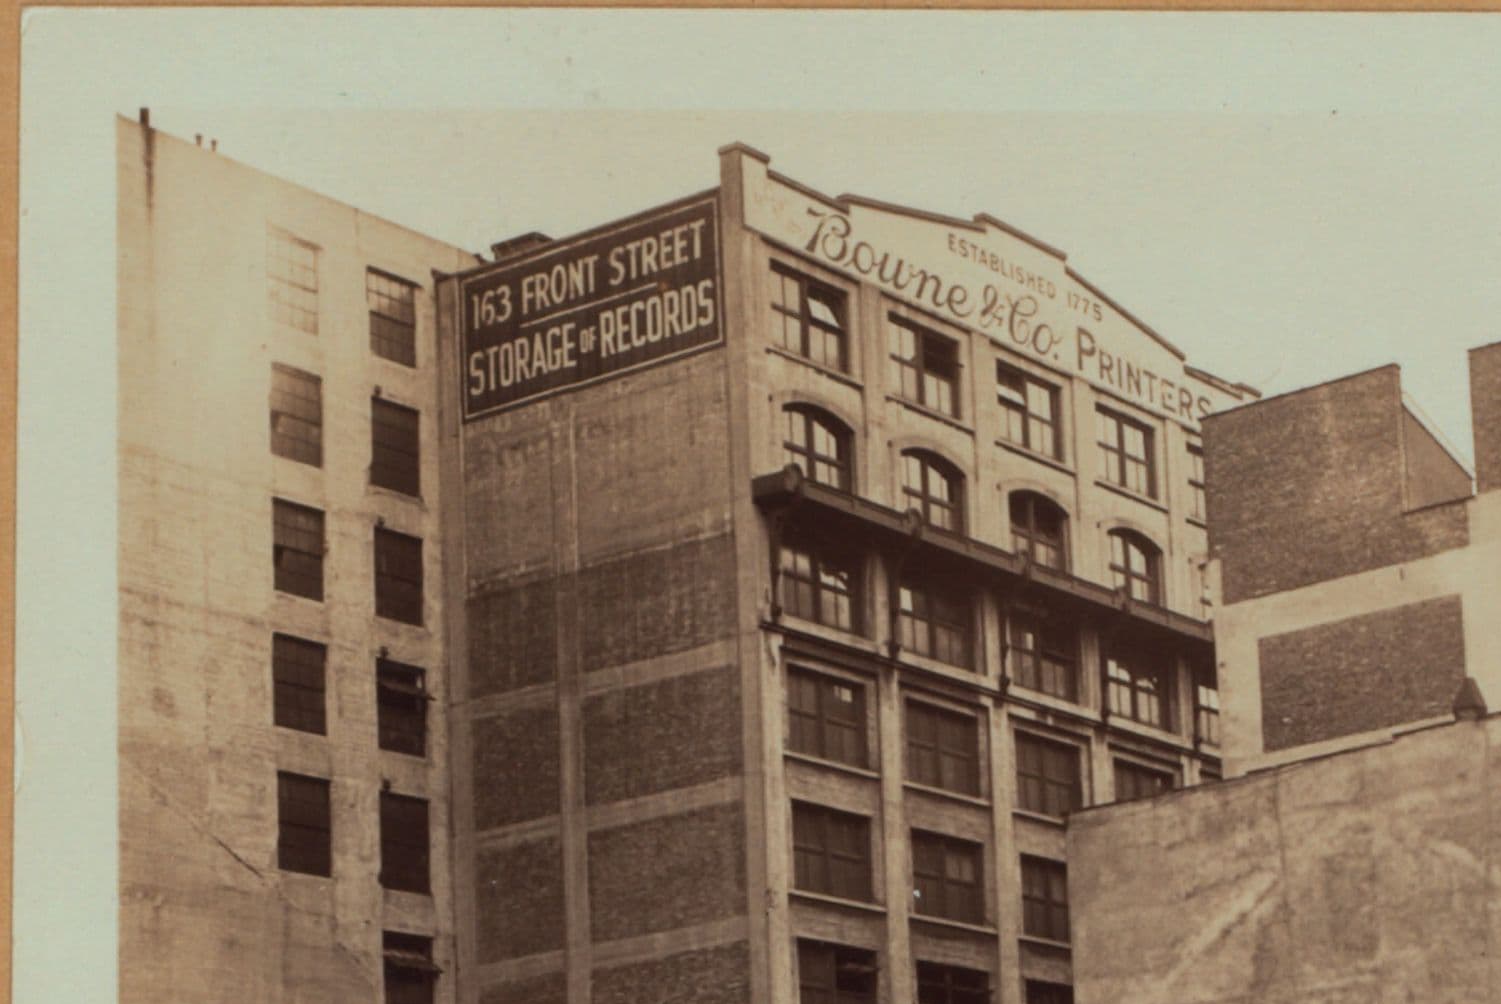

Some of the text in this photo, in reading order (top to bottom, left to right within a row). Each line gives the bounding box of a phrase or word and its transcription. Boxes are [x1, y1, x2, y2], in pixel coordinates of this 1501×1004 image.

[473, 218, 706, 330] 163 FRONT STREET
[806, 207, 973, 317] Bowne
[948, 232, 1103, 322] ESTABLISHED 1775
[469, 279, 715, 396] STORAGE OF RECORDS
[1077, 326, 1211, 420] PRINTERS
